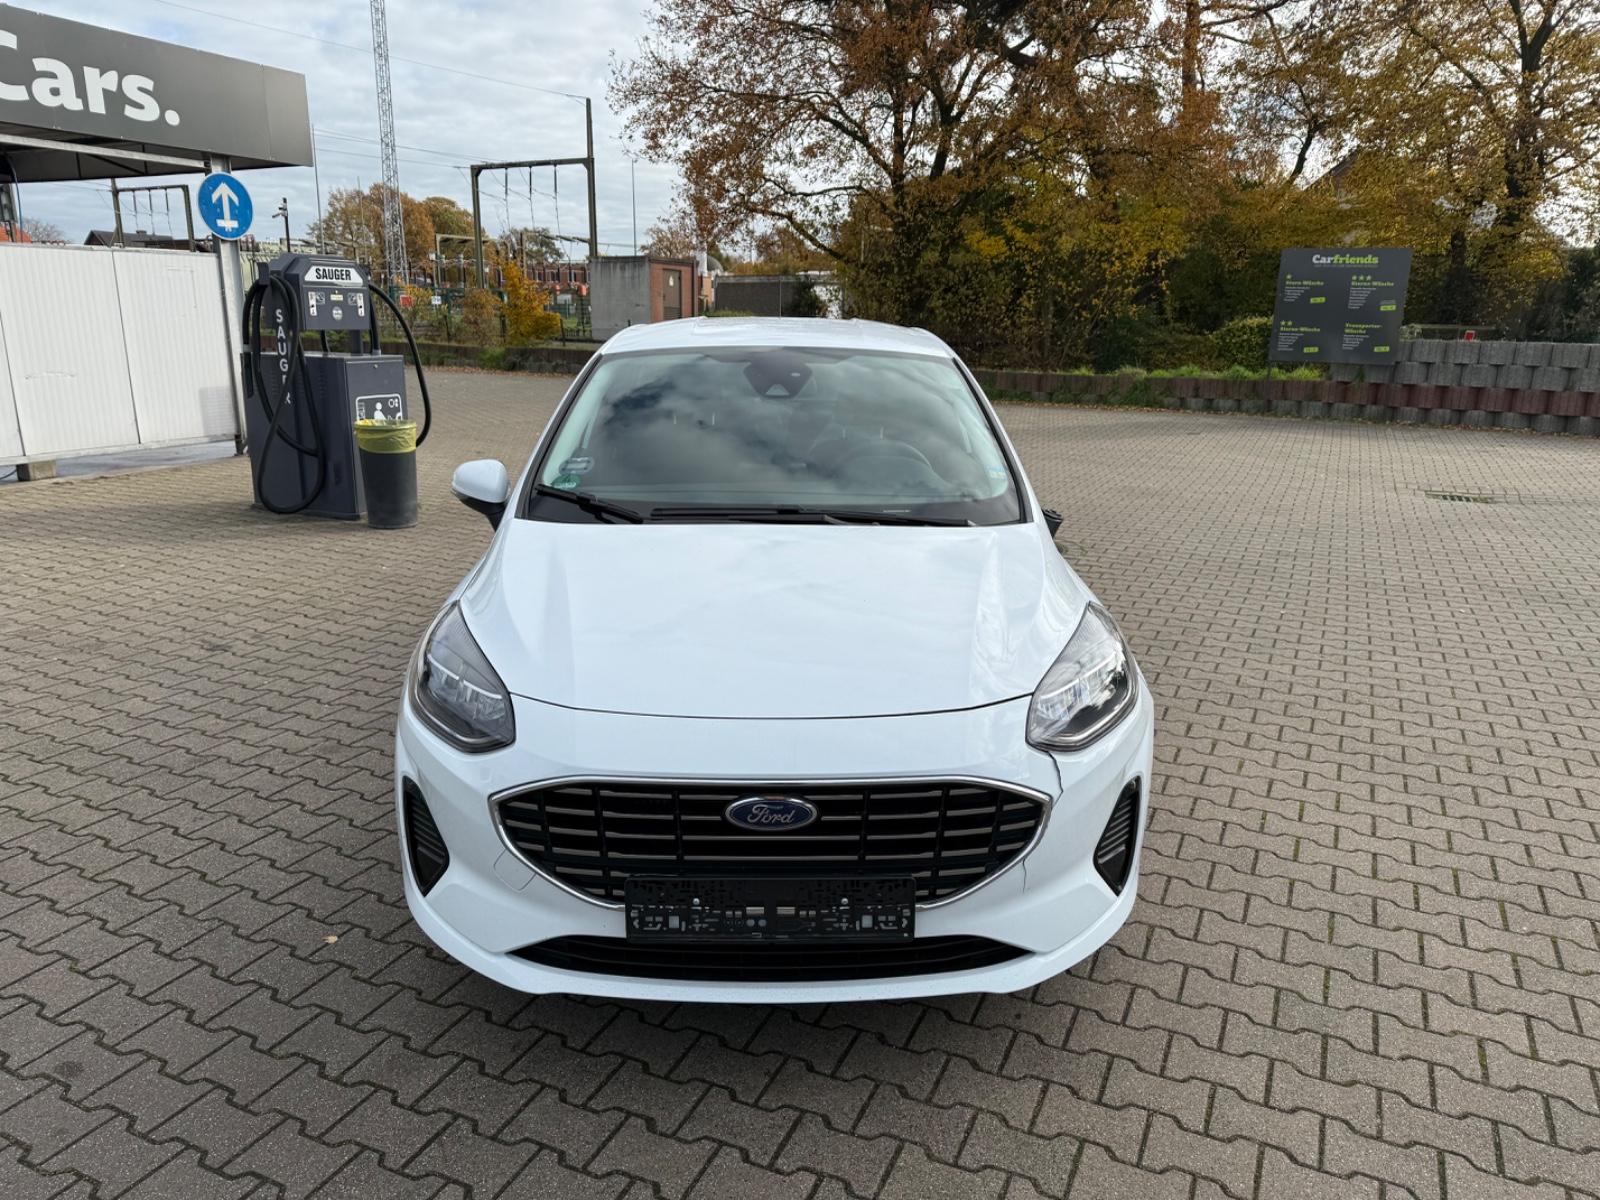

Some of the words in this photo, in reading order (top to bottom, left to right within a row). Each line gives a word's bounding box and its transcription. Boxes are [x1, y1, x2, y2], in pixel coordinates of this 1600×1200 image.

[1312, 254, 1379, 264] Carfriends
[315, 267, 352, 281] SAUGER
[747, 803, 796, 824] Ford
